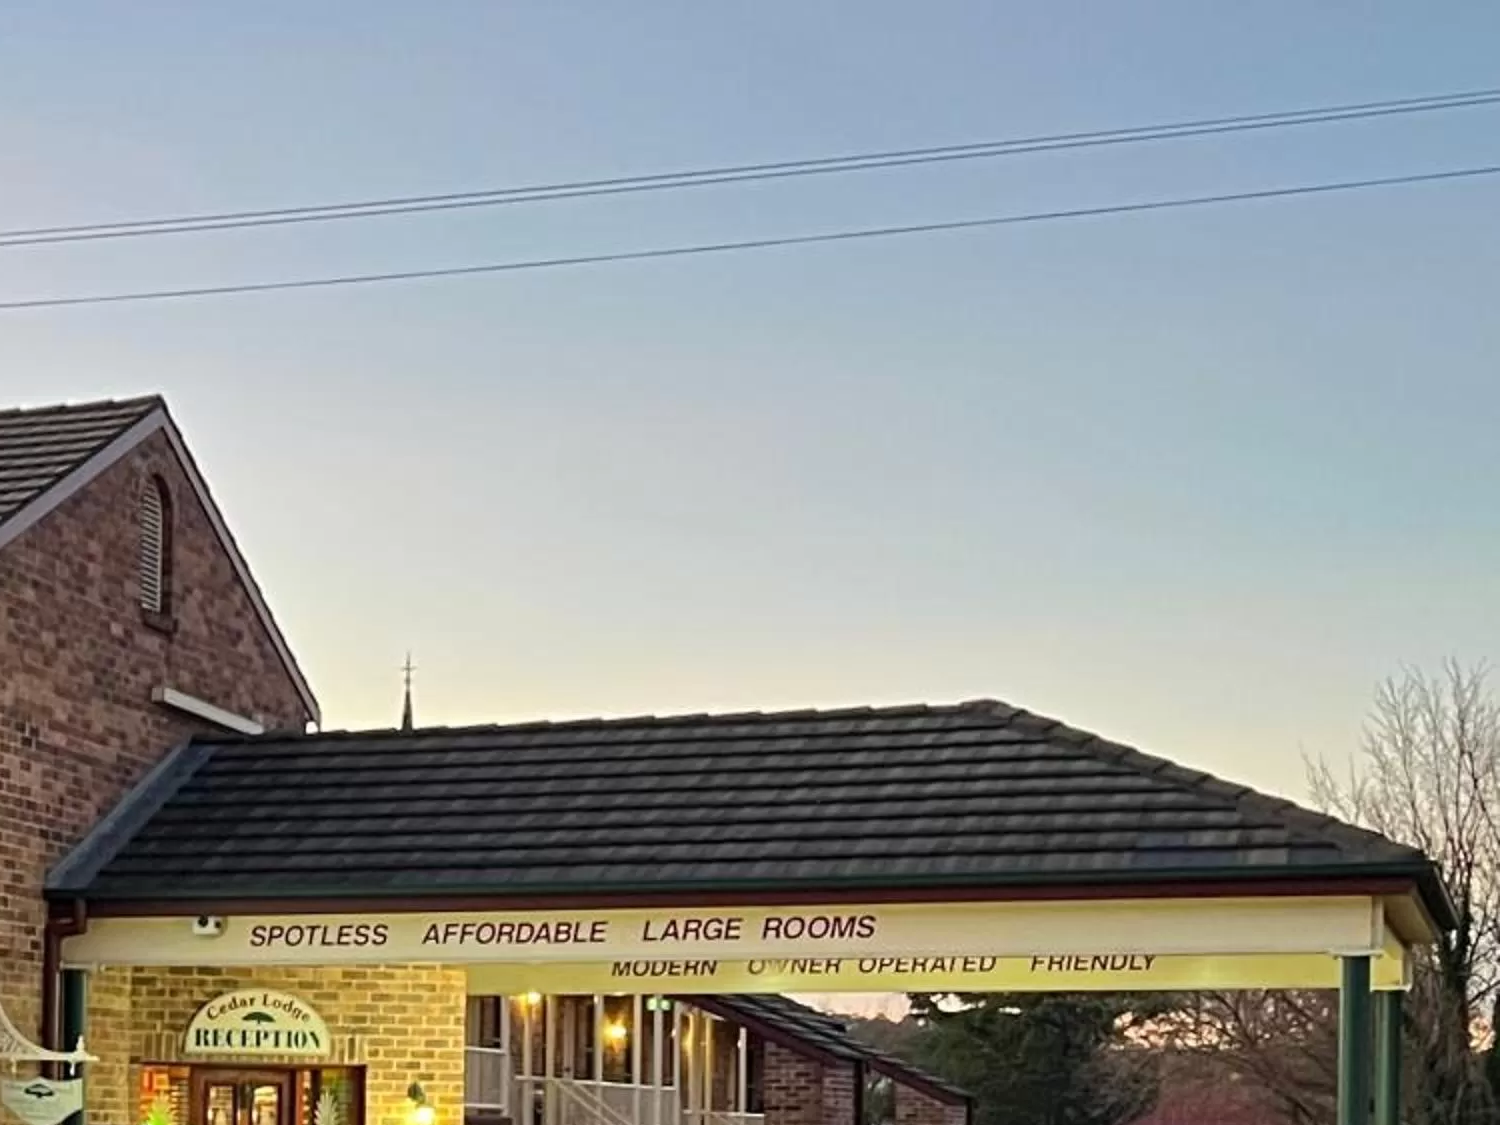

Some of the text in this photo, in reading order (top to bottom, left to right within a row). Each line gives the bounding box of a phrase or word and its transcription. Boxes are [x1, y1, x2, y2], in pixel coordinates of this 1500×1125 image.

[249, 915, 877, 947] SPOTLESS AFFORDABLE LARGE ROOMS
[611, 954, 1156, 977] MODERN OWNER OPERATED FRIENDLY
[206, 993, 311, 1023] Cedar Lodge
[195, 1028, 320, 1049] RECEPTION
